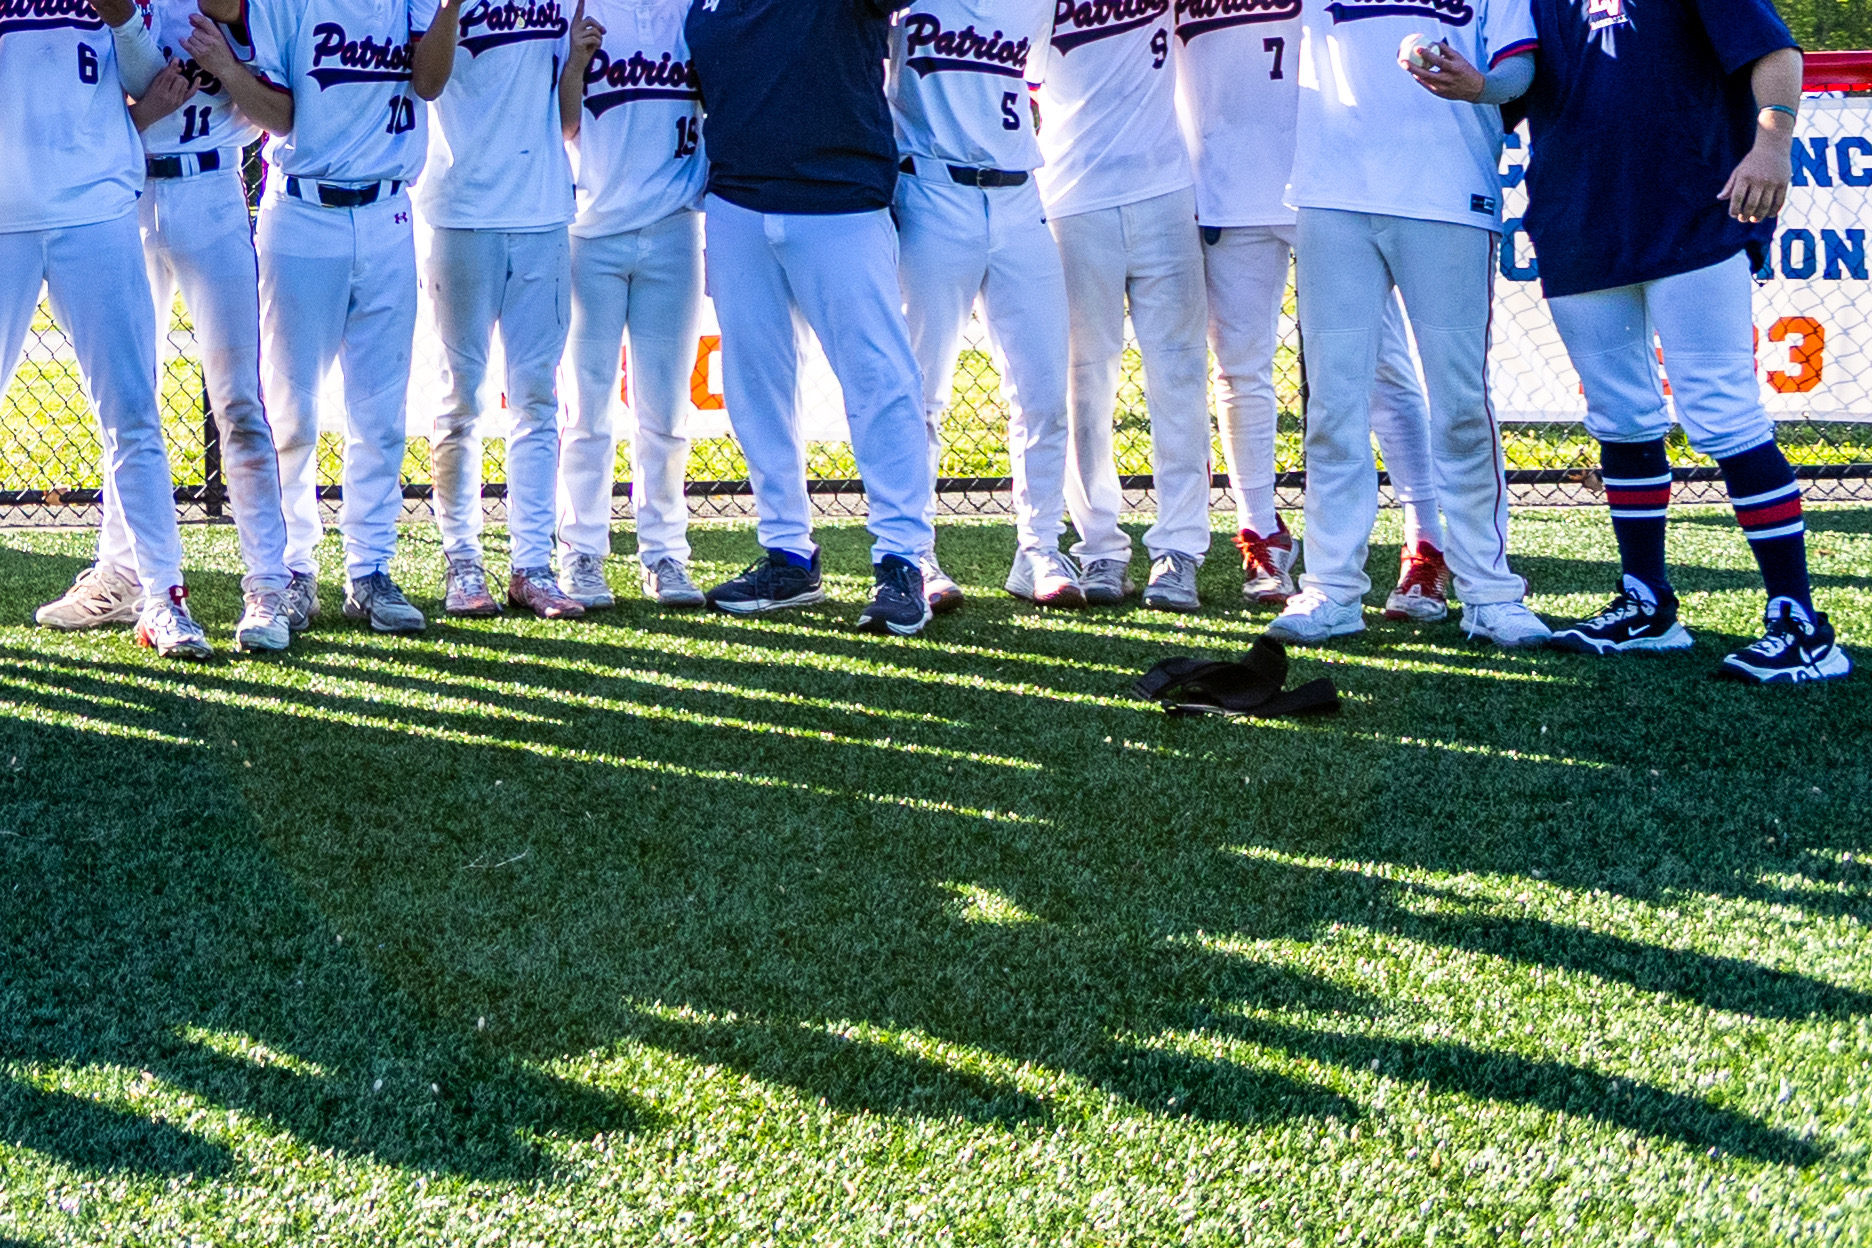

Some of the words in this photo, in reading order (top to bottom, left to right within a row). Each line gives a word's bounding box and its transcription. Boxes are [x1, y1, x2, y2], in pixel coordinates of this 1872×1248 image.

[78, 42, 98, 85] 6
[1263, 37, 1285, 80] 7
[180, 105, 212, 144] 11
[386, 94, 415, 134] 10
[1002, 92, 1020, 131] 5
